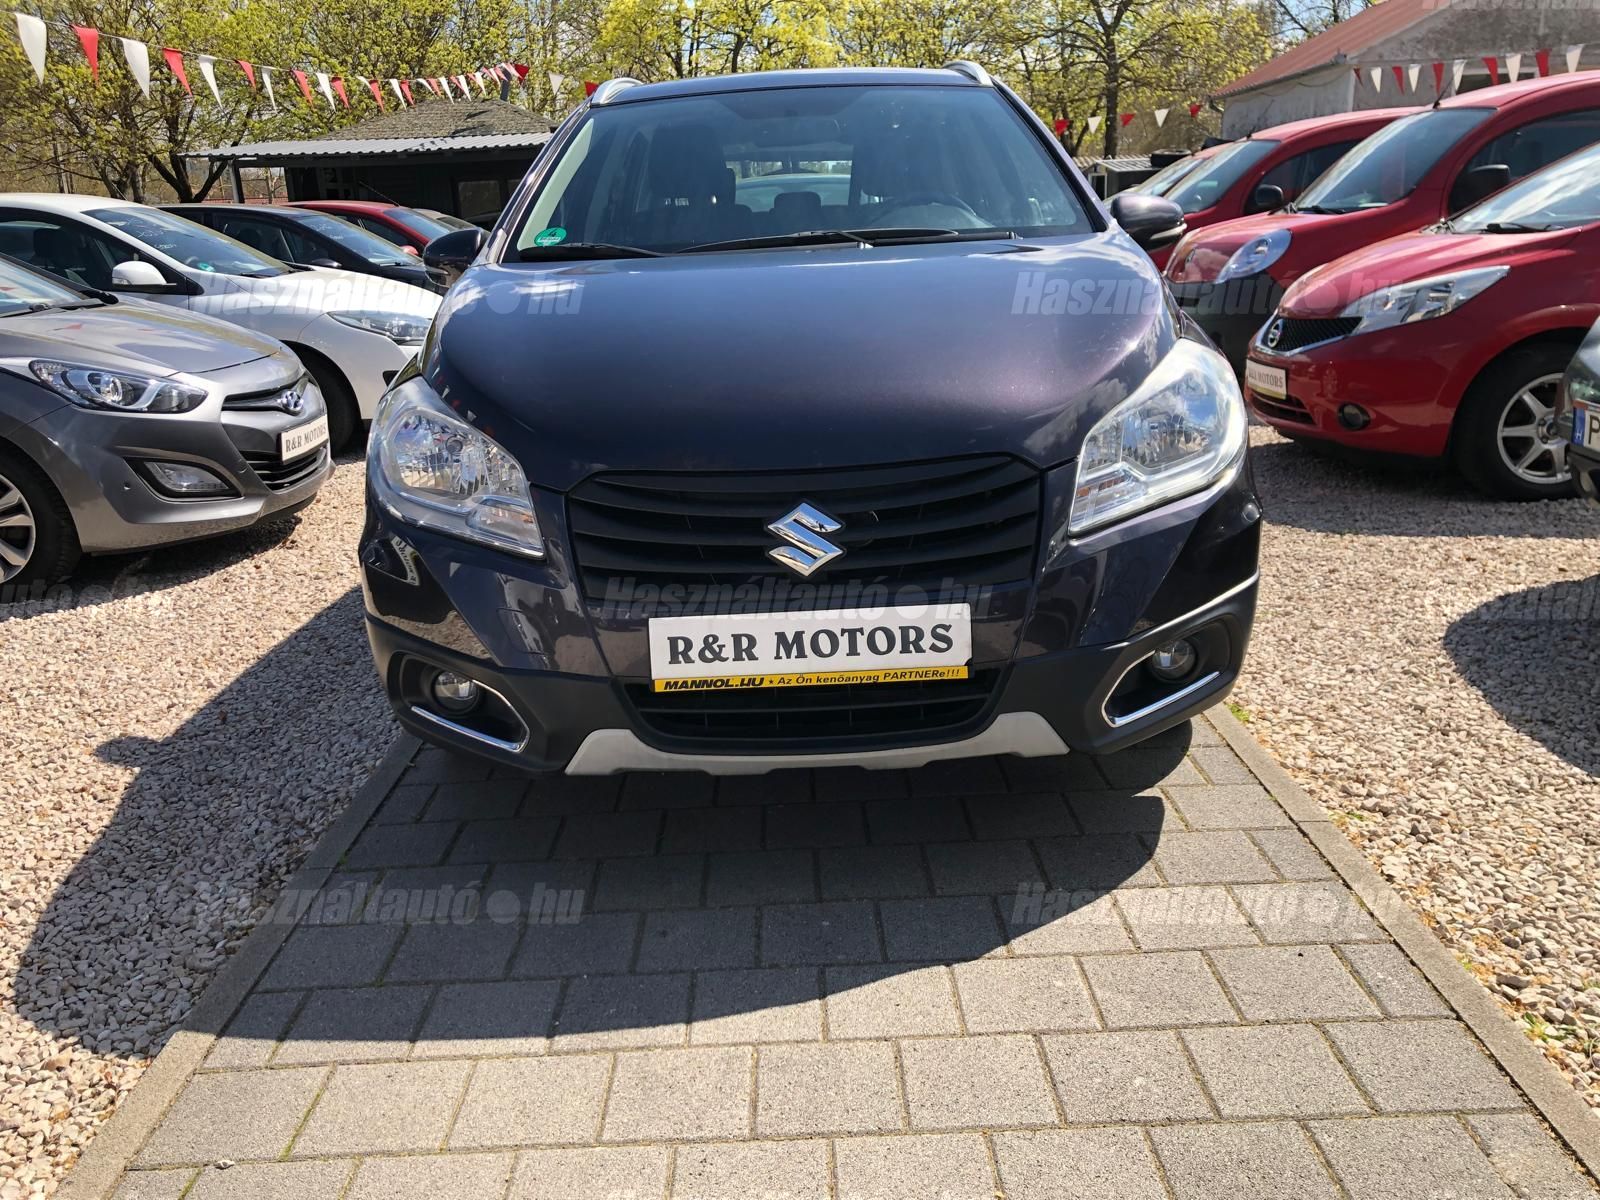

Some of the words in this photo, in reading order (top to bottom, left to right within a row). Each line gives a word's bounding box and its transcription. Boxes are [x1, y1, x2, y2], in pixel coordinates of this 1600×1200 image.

[667, 632, 759, 665] R&R
[774, 623, 955, 660] MOTORS
[664, 677, 765, 690] MANNOL.HU
[777, 677, 793, 685] Az
[796, 673, 813, 684] Ön
[883, 669, 960, 681] PARTNERe!!!
